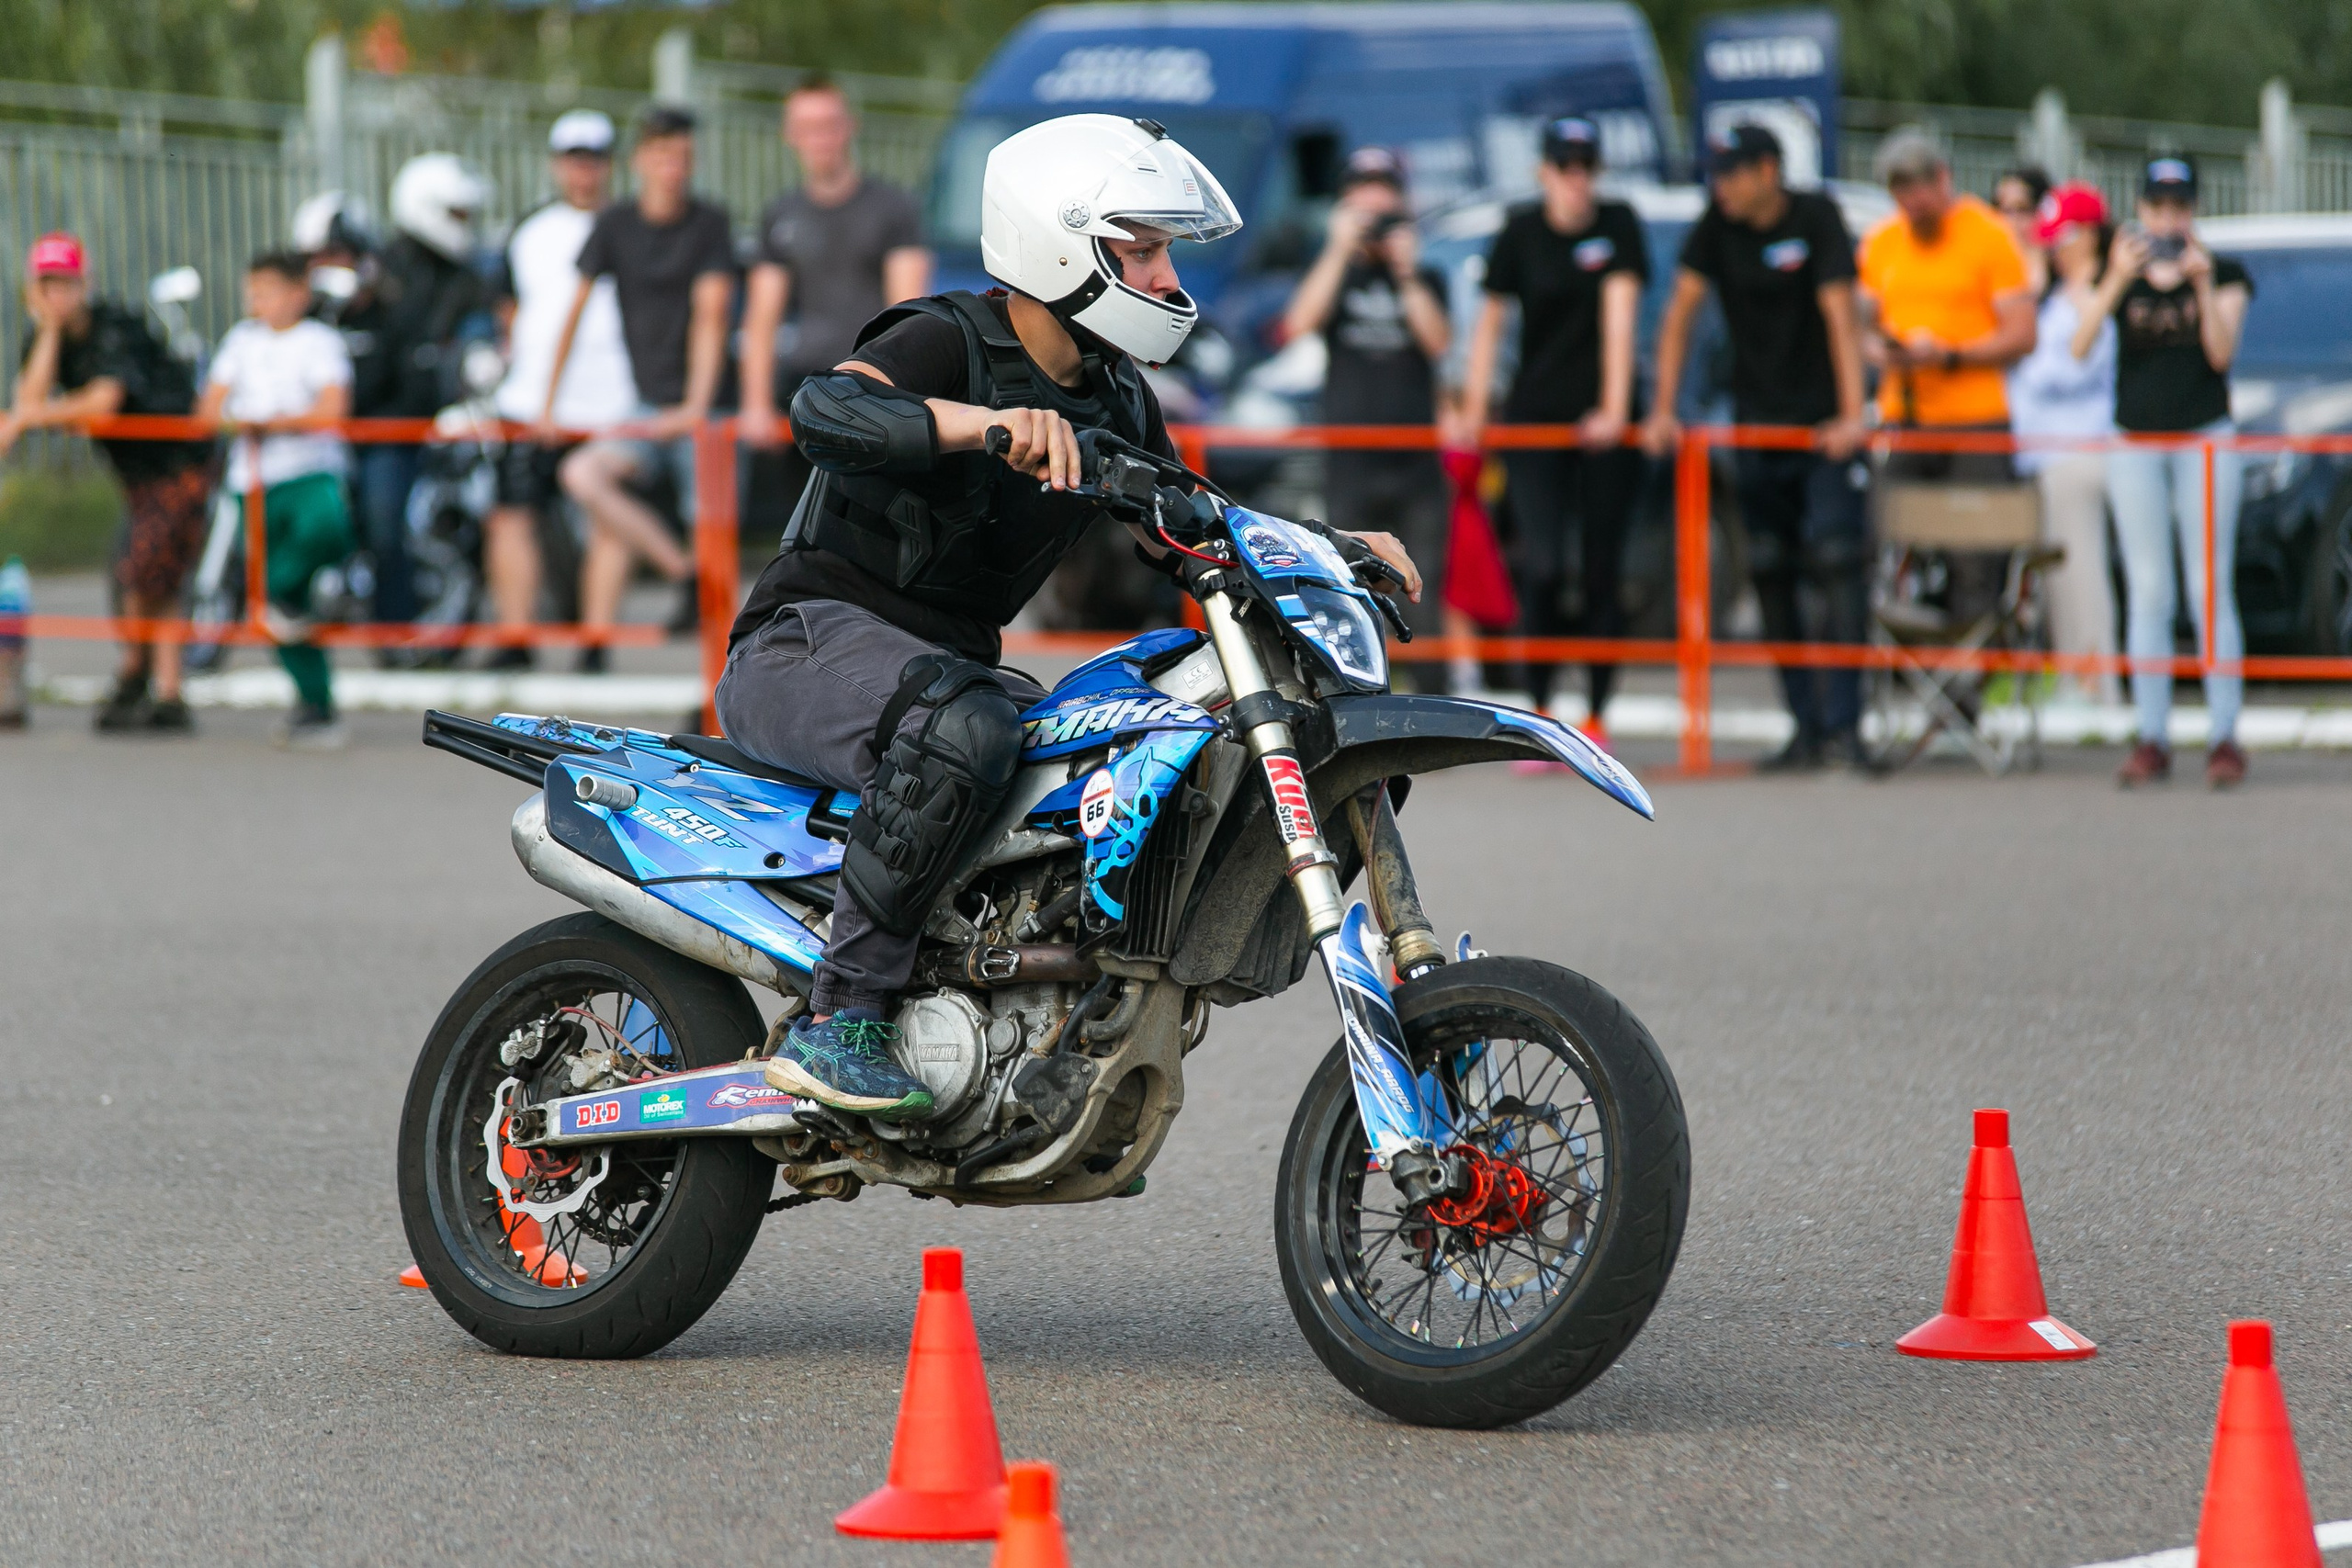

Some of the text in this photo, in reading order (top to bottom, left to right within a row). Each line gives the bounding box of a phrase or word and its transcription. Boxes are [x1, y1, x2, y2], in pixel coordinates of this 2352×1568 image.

[1021, 696, 1211, 749] MAHA
[628, 805, 705, 845] TUNT
[1086, 799, 1104, 822] 66
[661, 807, 749, 849] 450F
[920, 1046, 957, 1059] YAMAHA
[643, 1100, 685, 1114] MOTOREX
